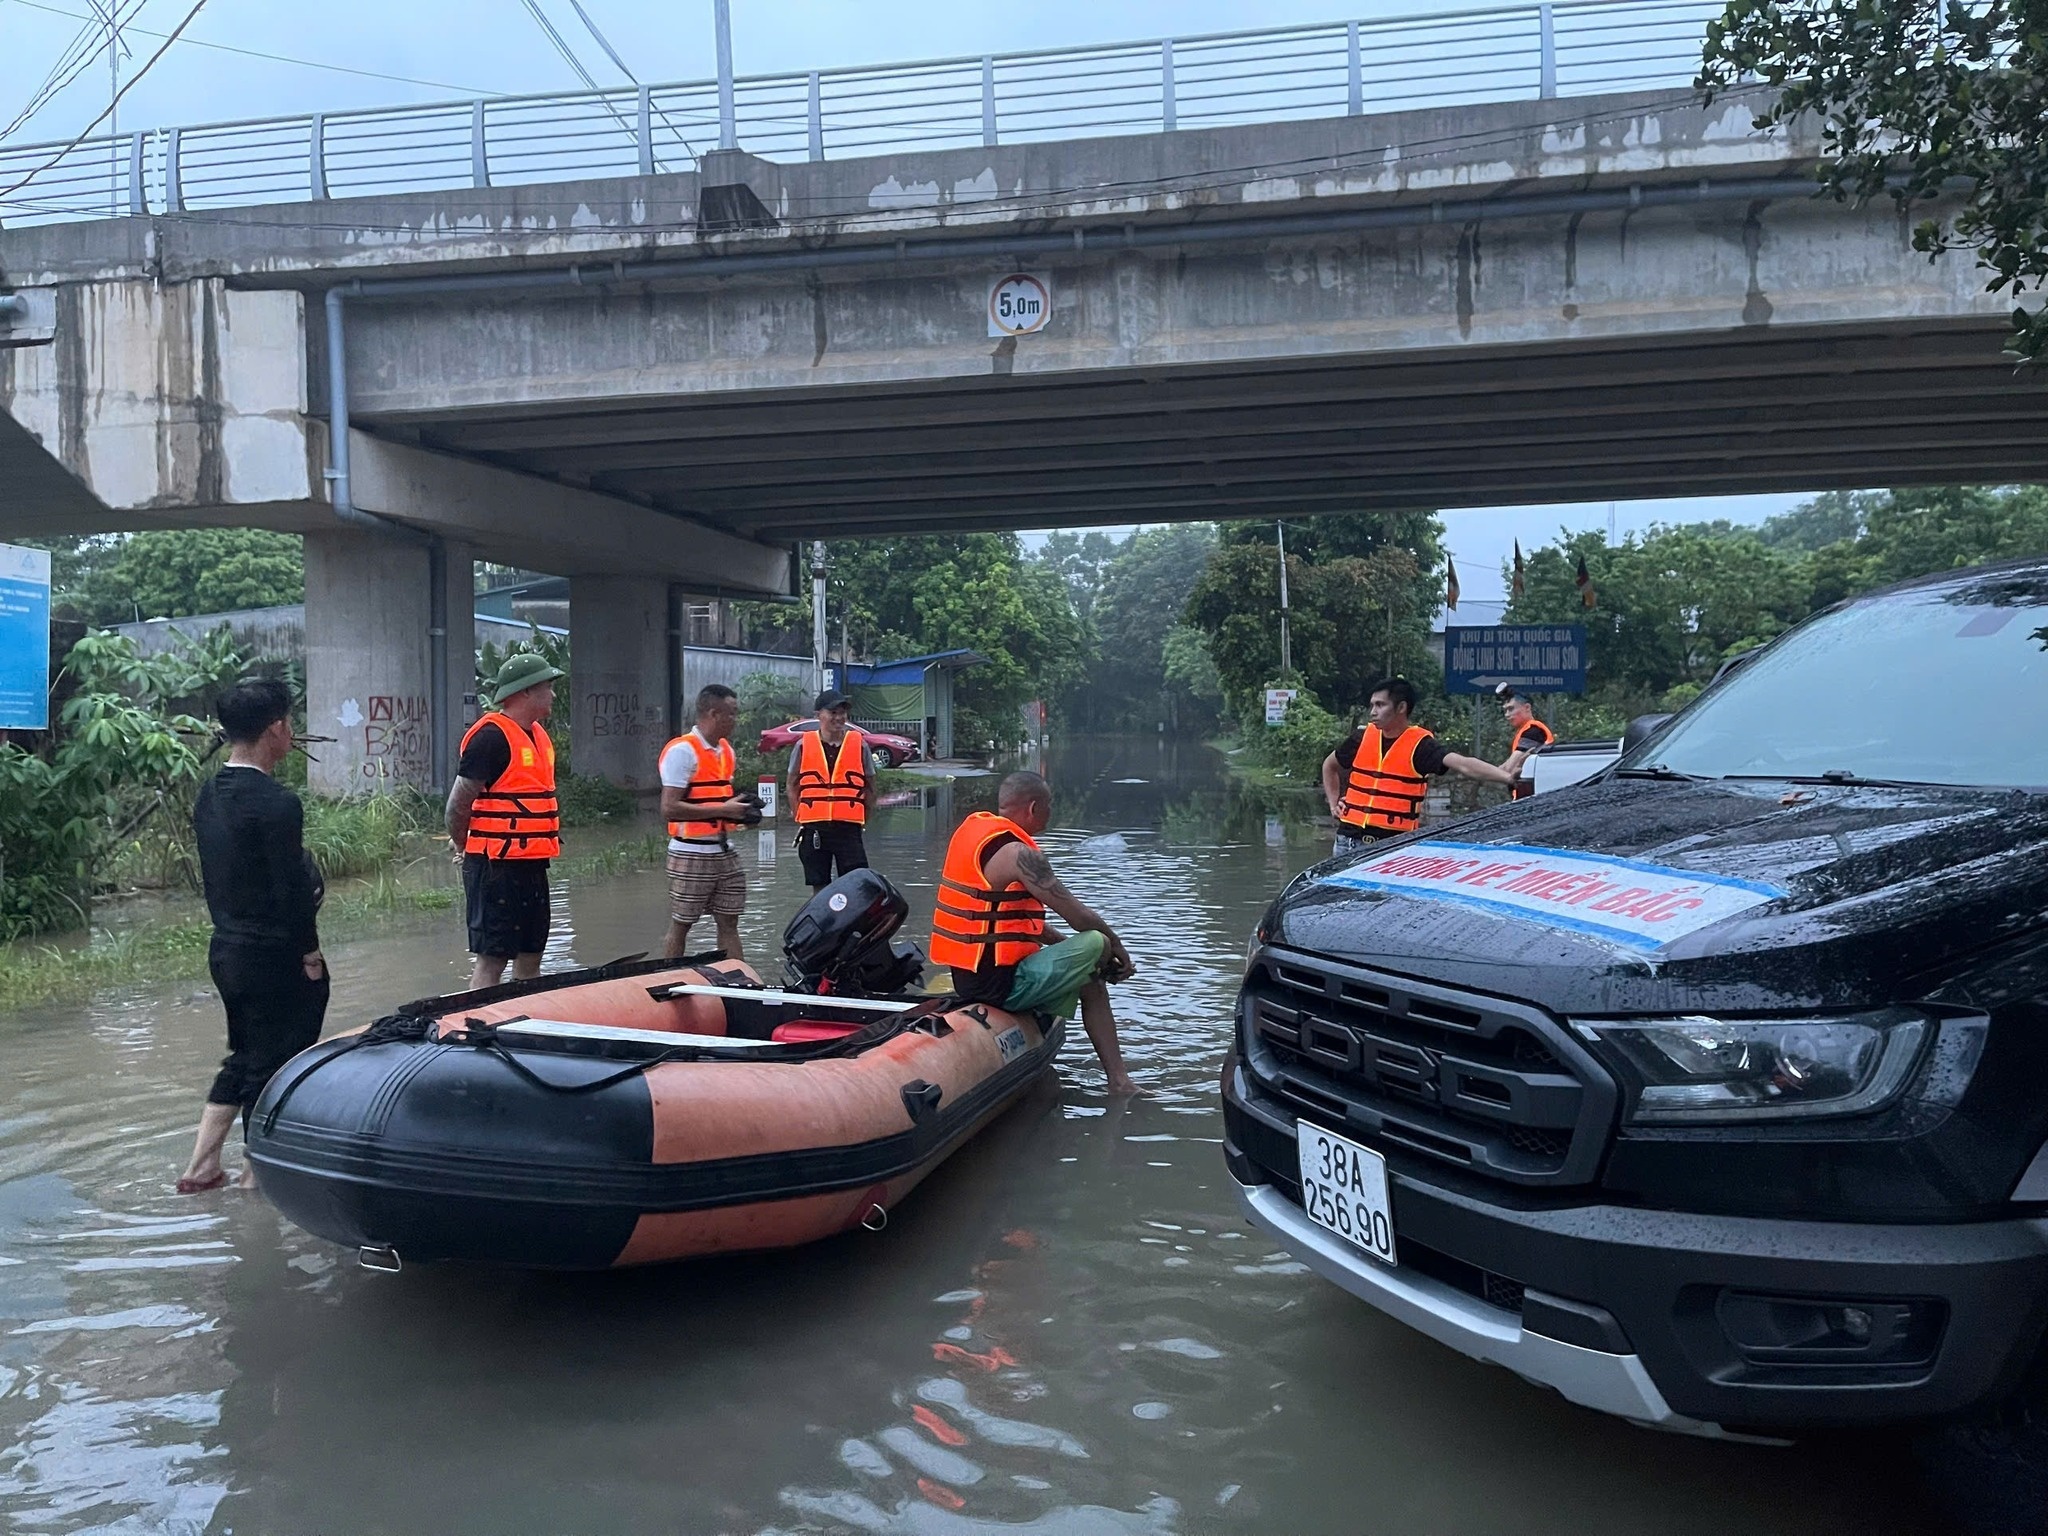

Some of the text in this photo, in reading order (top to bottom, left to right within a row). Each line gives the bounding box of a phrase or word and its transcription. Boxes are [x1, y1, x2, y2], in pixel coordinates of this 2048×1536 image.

[999, 292, 1040, 318] 5,0m
[1460, 630, 1481, 643] KHU
[1484, 630, 1494, 643] DI
[1523, 627, 1551, 643] QUỐC
[1554, 629, 1572, 641] GIA
[1476, 647, 1495, 670] LINH
[1542, 646, 1560, 670] LINH
[1455, 860, 1541, 886] VỀ
[1494, 869, 1620, 905] MIỀN
[1588, 886, 1703, 922] BẮC
[1317, 1136, 1366, 1197] 38A
[1304, 1178, 1391, 1256] 256.90
